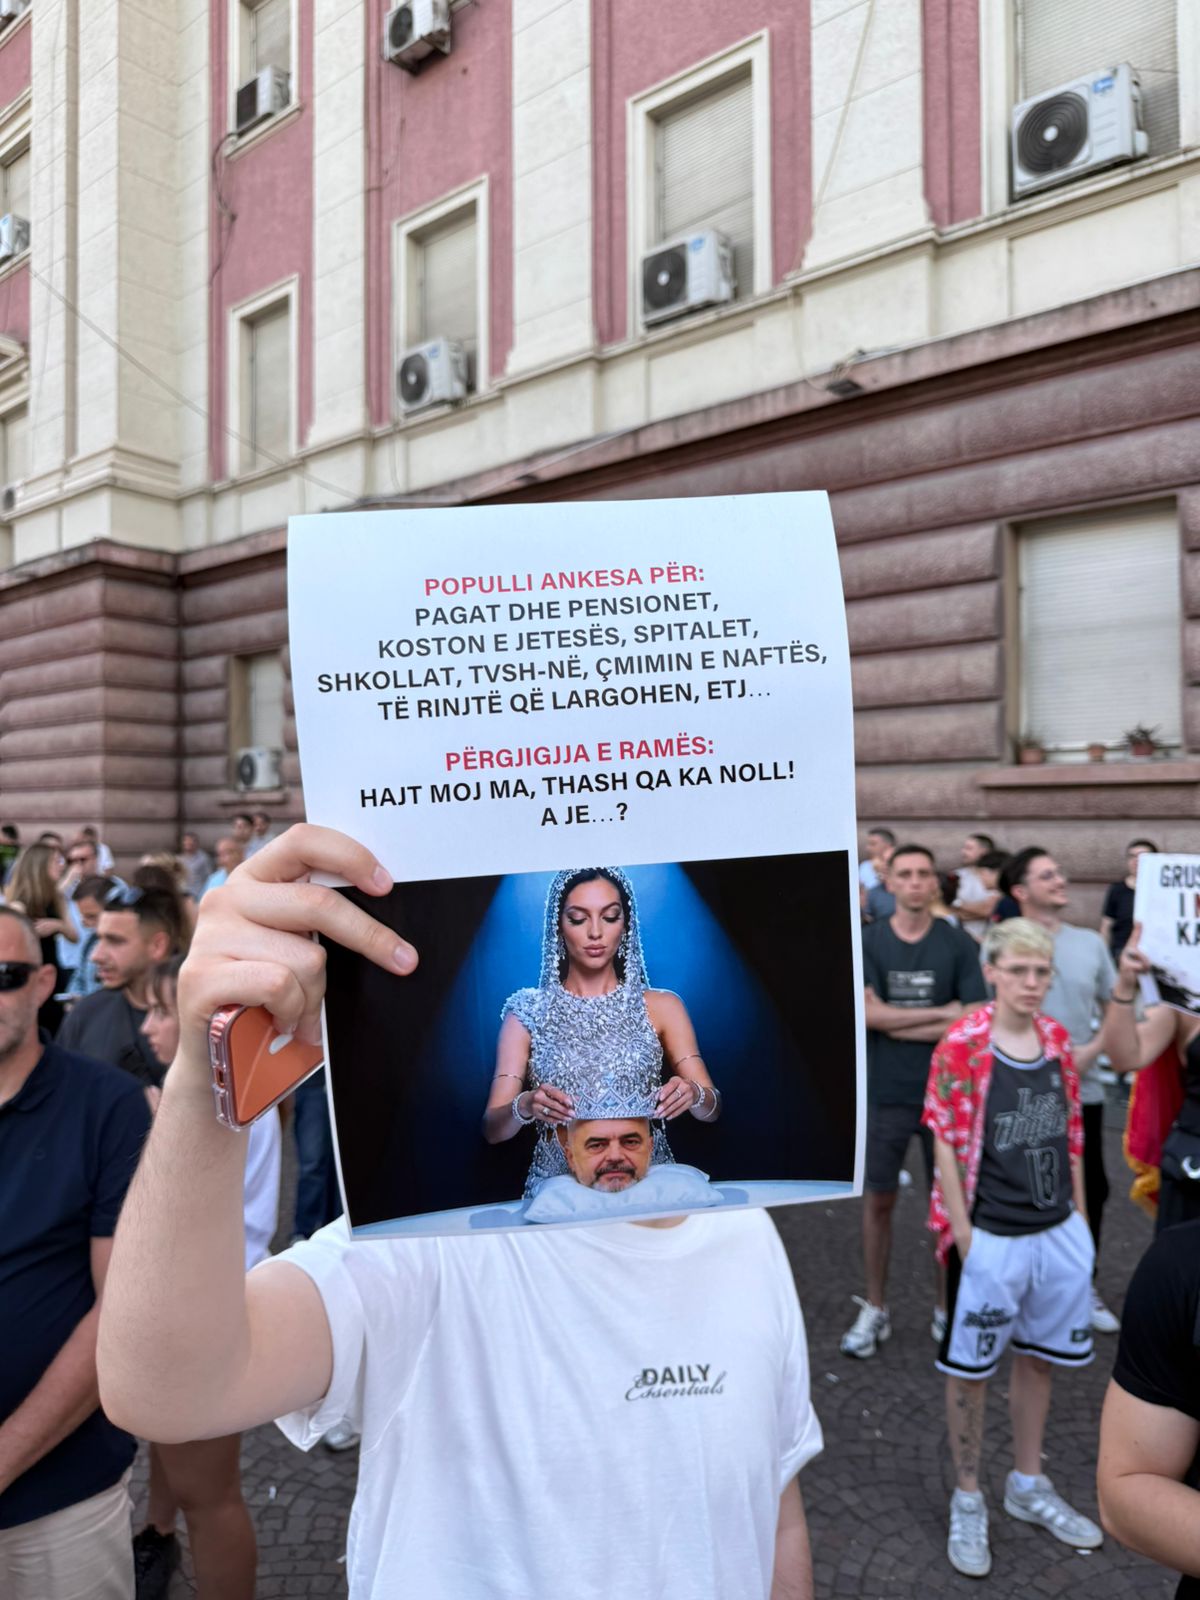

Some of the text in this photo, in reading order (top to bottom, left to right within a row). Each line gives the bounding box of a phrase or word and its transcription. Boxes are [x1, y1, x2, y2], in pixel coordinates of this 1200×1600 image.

[424, 561, 705, 597] POPULLI ANKESA PËR:
[415, 591, 719, 627] PAGAT DHE PENSIONET,
[378, 618, 759, 659] KOSTON E JETESËS, SPITALET,
[317, 643, 828, 694] SHKOLLAT, TVSH-NË, ÇMIMIN E NAFTËS,
[376, 695, 410, 721] TË
[416, 689, 503, 719] RINJTË
[509, 686, 545, 715] QË
[551, 682, 700, 711] LARGOHEN,
[445, 735, 714, 772] PËRGJIGJJA E RAMËS:
[360, 760, 795, 809] HAJT MOJ MA, THASH QA KA NOLL!
[540, 807, 559, 827] A
[641, 1363, 711, 1386] DAILY
